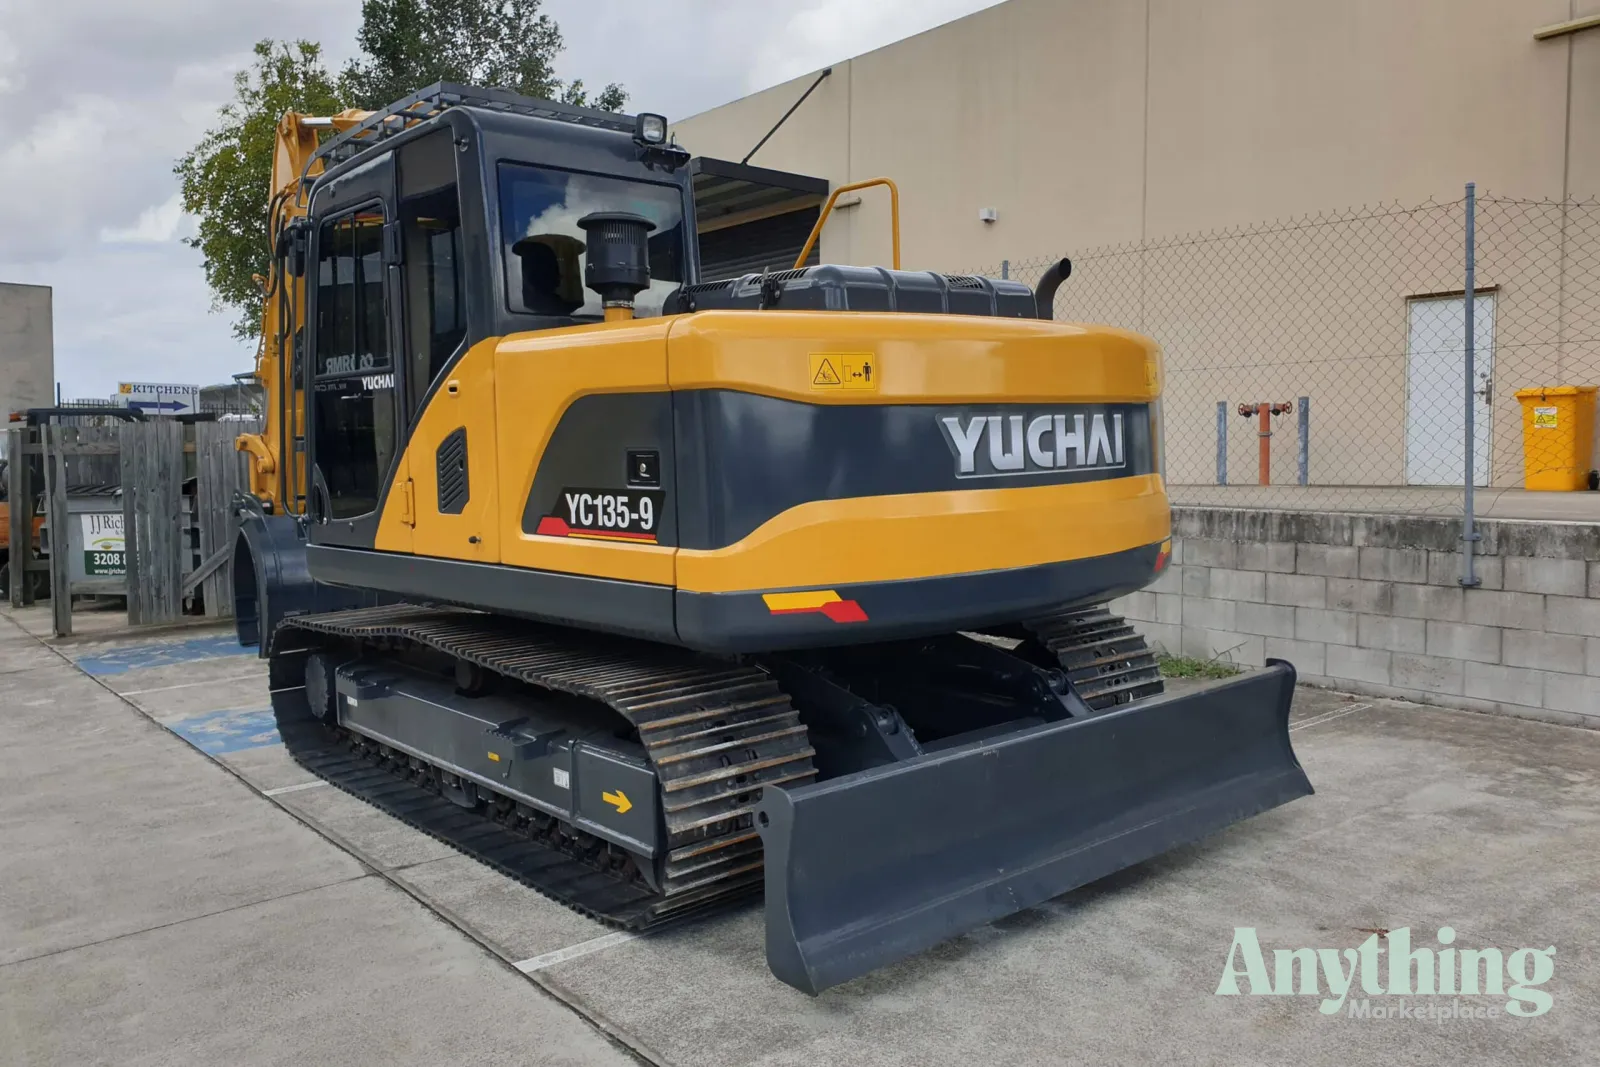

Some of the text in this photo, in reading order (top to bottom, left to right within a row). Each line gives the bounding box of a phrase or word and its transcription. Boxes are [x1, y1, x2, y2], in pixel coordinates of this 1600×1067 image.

[133, 384, 198, 395] KITCHENS
[361, 374, 394, 390] YUCHAI
[942, 414, 1124, 473] YUCHAI
[565, 493, 653, 530] YC135-9
[94, 553, 120, 565] 3208
